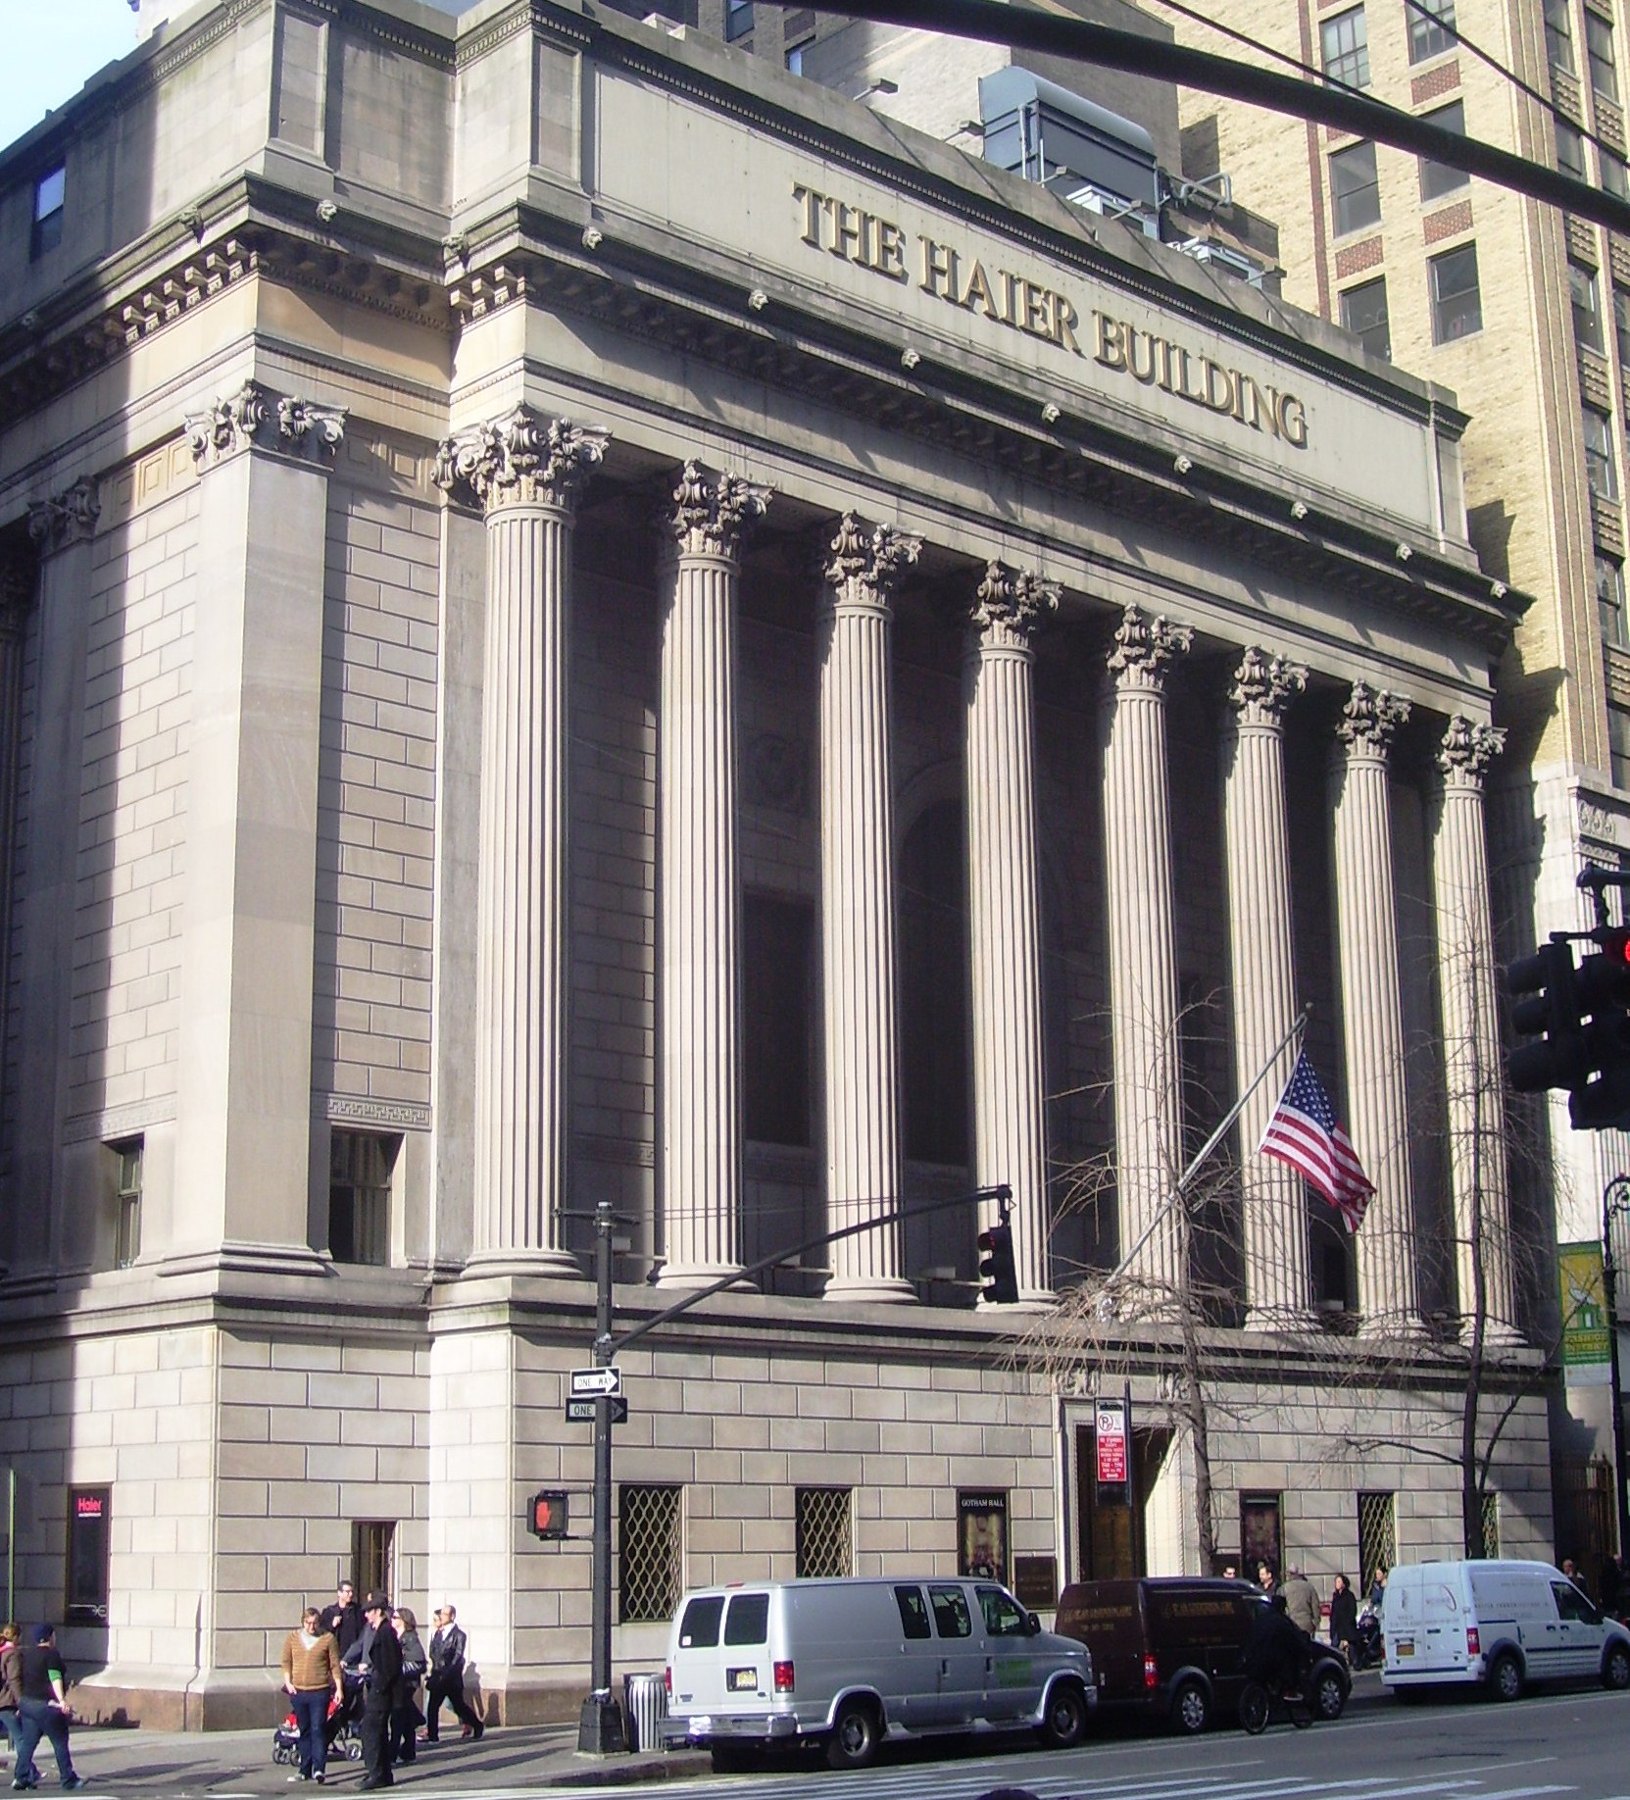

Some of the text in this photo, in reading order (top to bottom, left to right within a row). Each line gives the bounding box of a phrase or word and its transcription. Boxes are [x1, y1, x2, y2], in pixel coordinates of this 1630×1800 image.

[793, 181, 1308, 449] THE HAIER BUILDING
[577, 1377, 613, 1387] ONE WAY
[573, 1405, 593, 1416] ONE
[78, 1497, 102, 1512] Haier
[961, 1498, 1004, 1507] GOTHAM HALL
